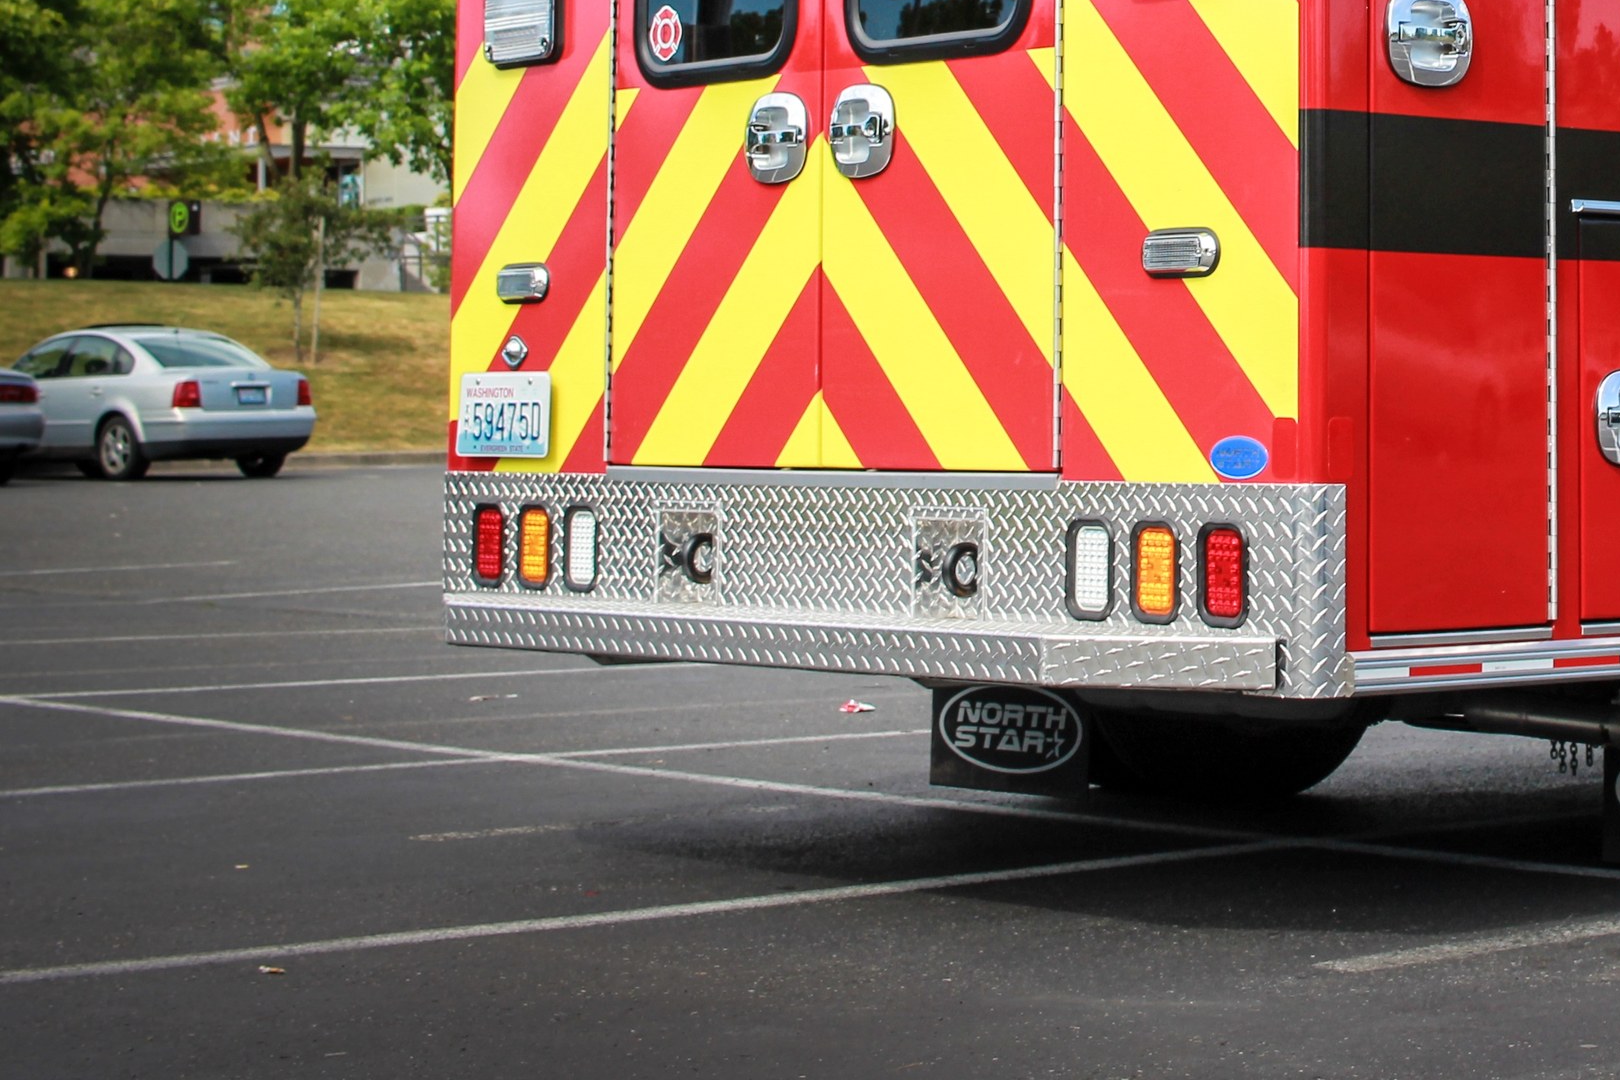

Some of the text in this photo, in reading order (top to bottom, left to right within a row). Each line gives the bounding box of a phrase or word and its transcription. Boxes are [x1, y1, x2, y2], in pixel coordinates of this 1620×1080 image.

[466, 387, 514, 398] WASHINGTON
[472, 402, 541, 441] 59475D
[957, 700, 1067, 730] NORTH
[954, 725, 1046, 754] STAR
